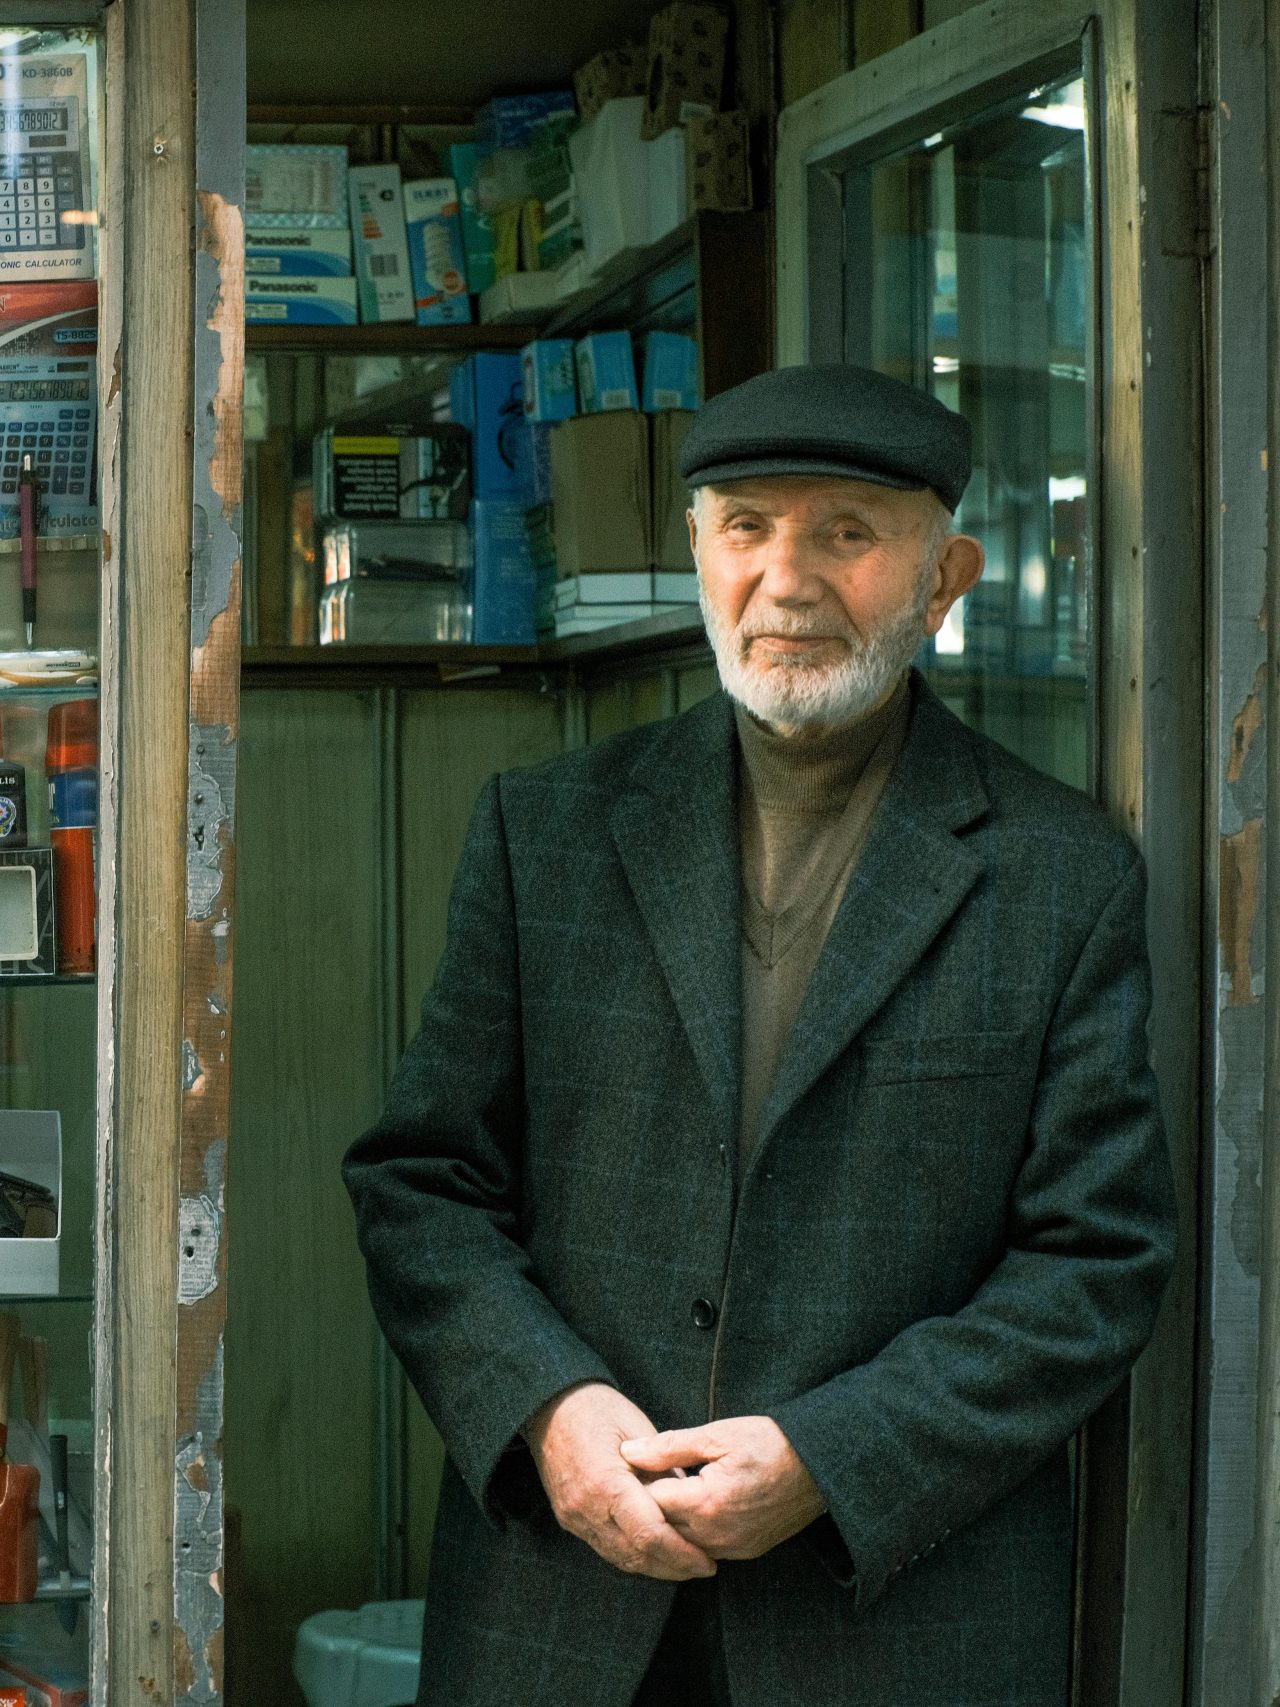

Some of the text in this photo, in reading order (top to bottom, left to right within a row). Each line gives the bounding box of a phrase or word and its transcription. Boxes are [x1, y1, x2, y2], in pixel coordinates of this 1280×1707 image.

[22, 67, 73, 79] KD-3860B
[246, 234, 312, 247] Panasonic
[24, 258, 83, 269] CALCULATOR
[249, 279, 318, 294] Panasonic
